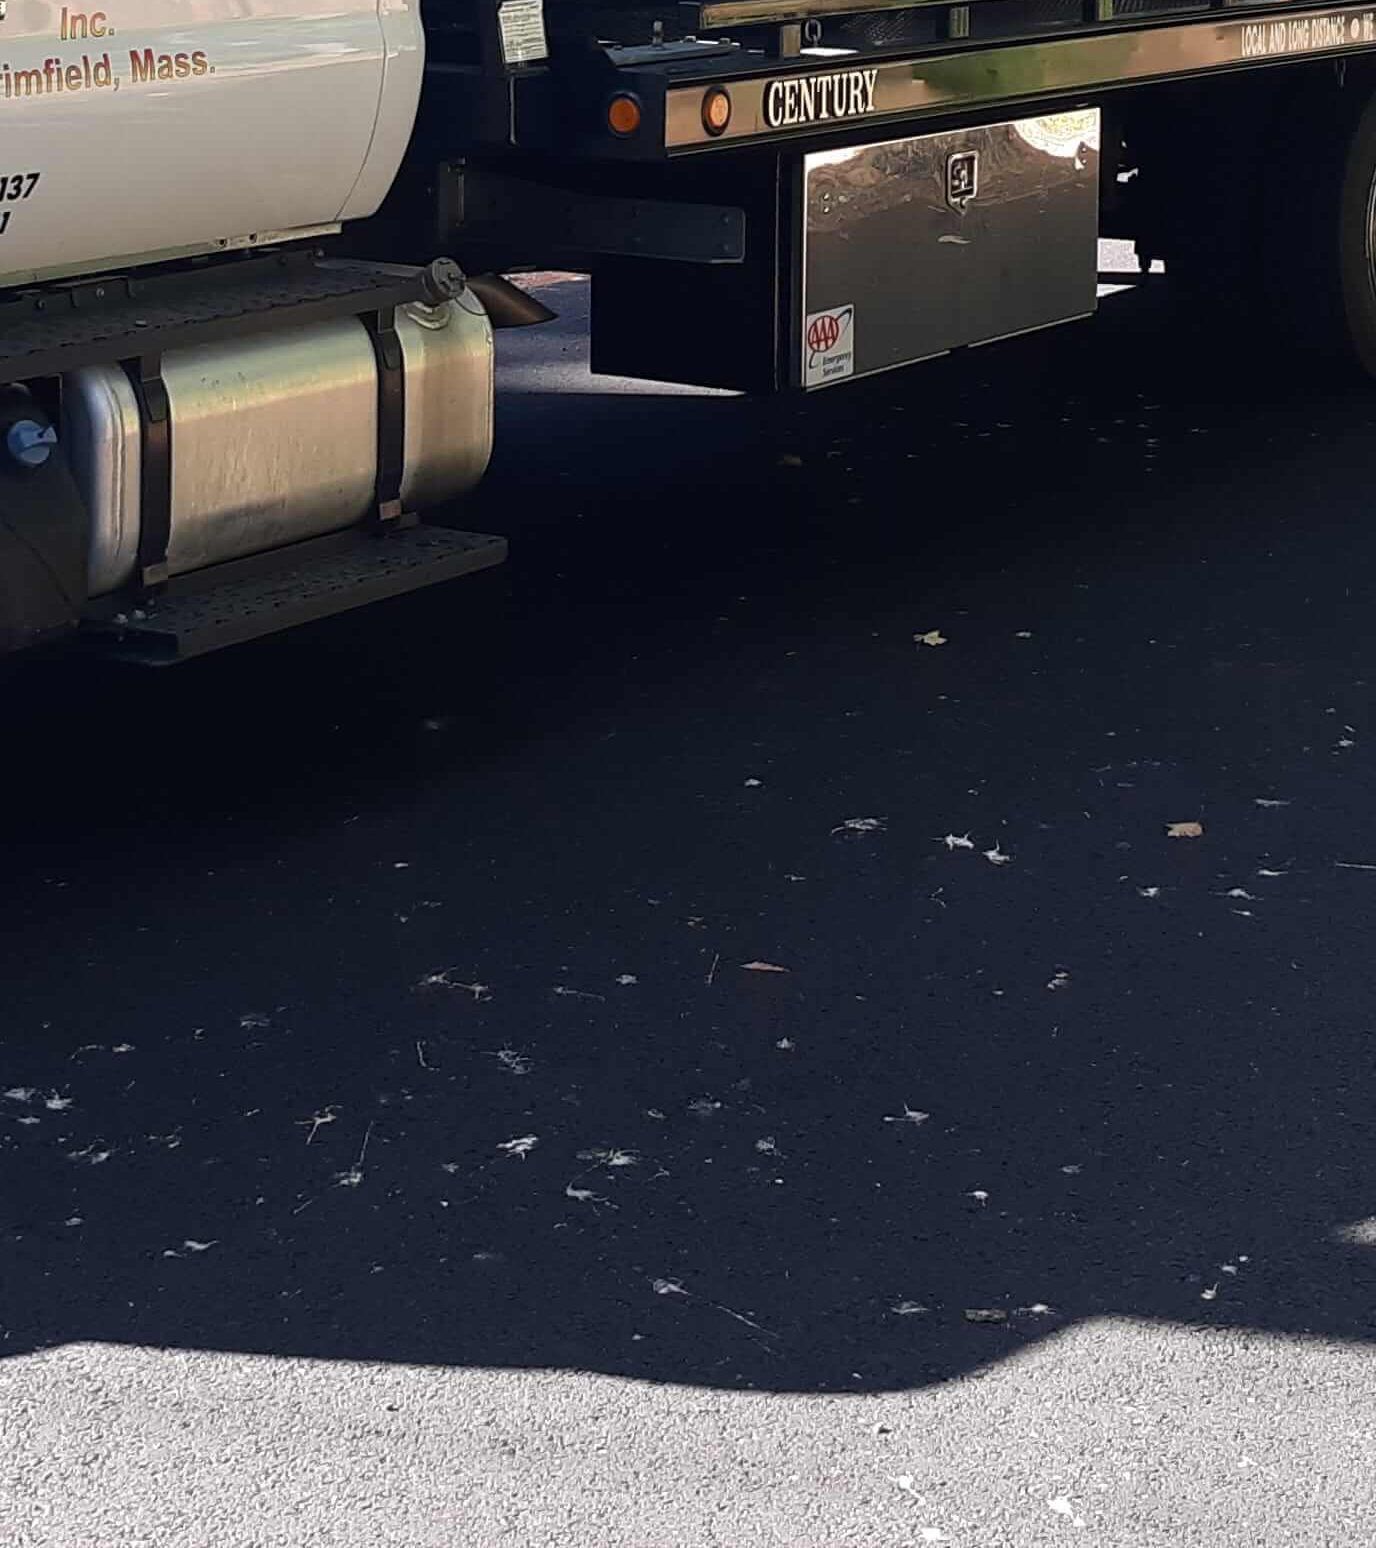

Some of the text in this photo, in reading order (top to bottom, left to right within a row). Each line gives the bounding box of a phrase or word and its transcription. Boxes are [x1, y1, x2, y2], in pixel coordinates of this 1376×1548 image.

[60, 7, 115, 40] Inc.
[1241, 24, 1266, 57] LOCAL
[1269, 22, 1286, 53] AND
[1288, 19, 1309, 51] LONG
[1311, 15, 1345, 47] DISTANCE
[129, 48, 216, 83] Mass.
[768, 68, 878, 127] CENTURY
[810, 317, 837, 351] AAA
